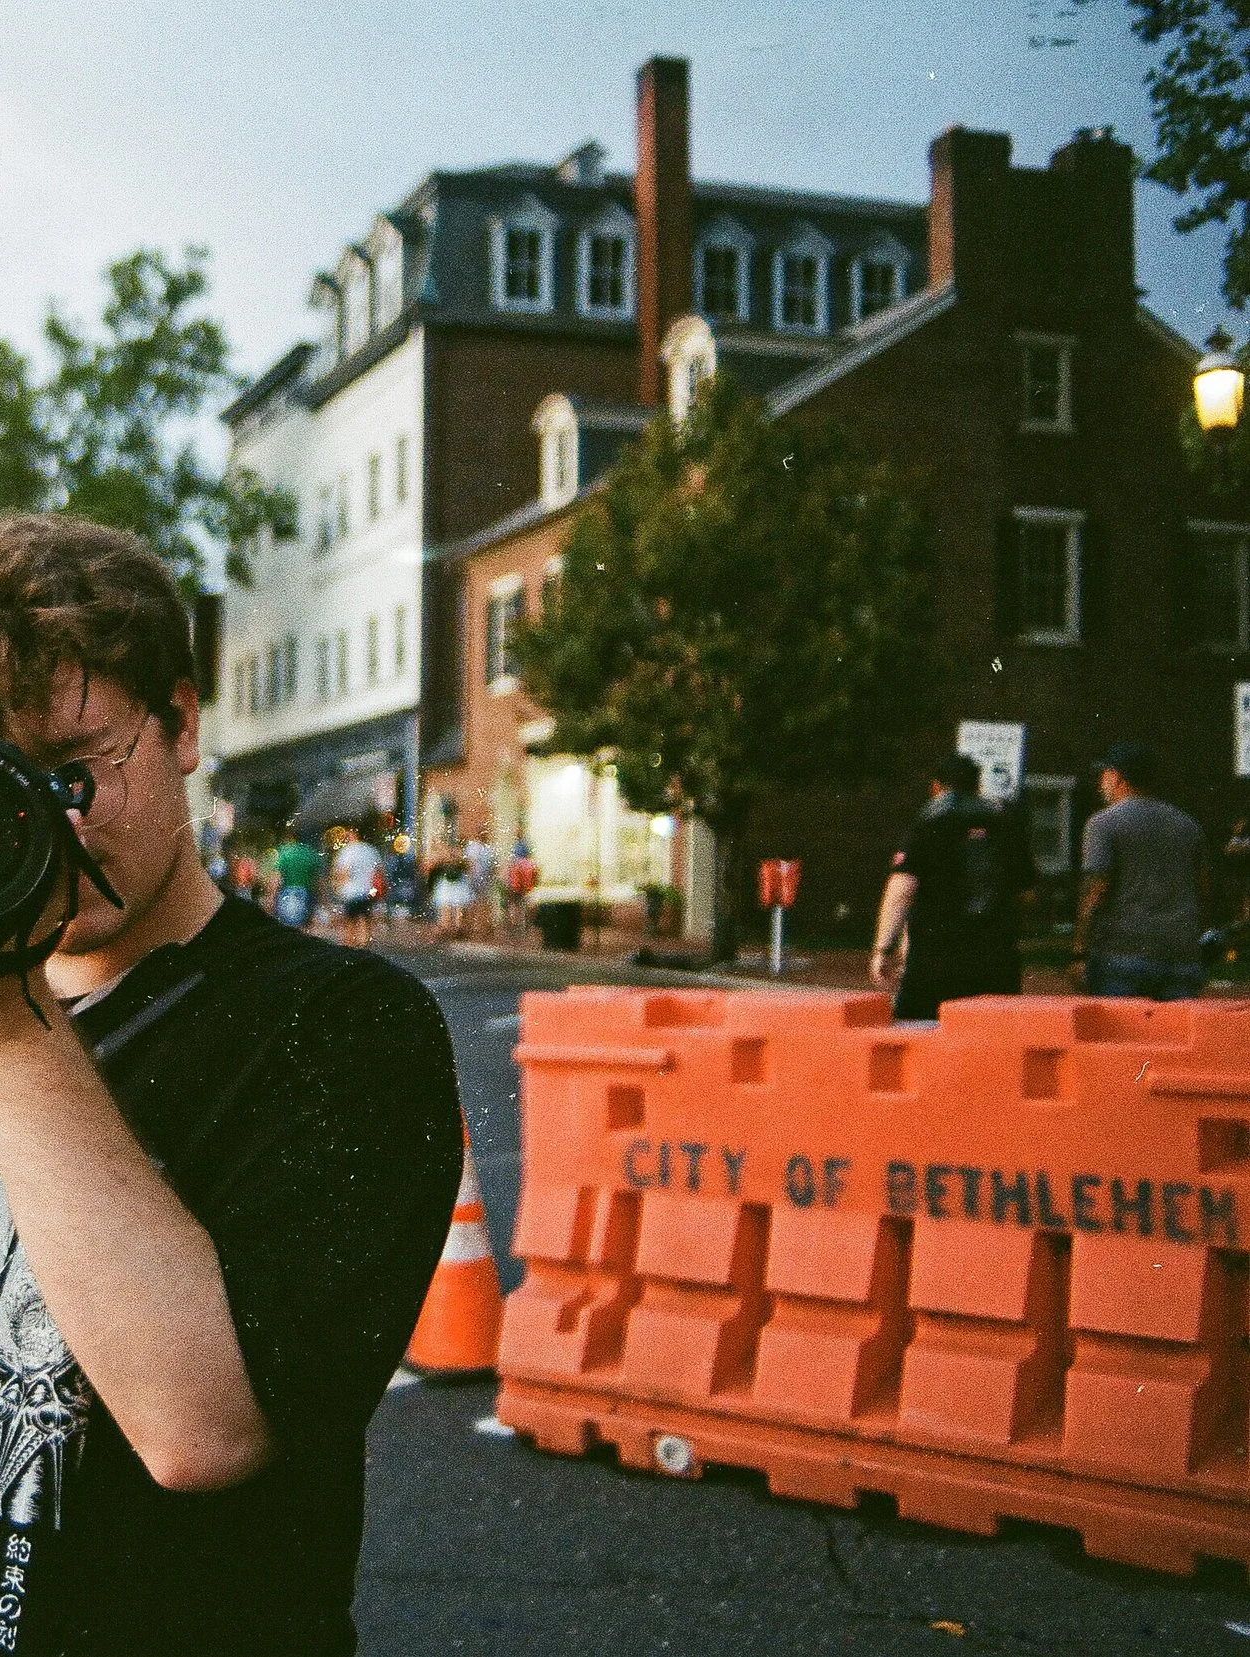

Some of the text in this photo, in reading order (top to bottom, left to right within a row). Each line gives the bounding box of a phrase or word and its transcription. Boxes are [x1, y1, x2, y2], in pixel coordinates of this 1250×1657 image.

[625, 1139, 1237, 1247] CITY OF BETHLEHEM
